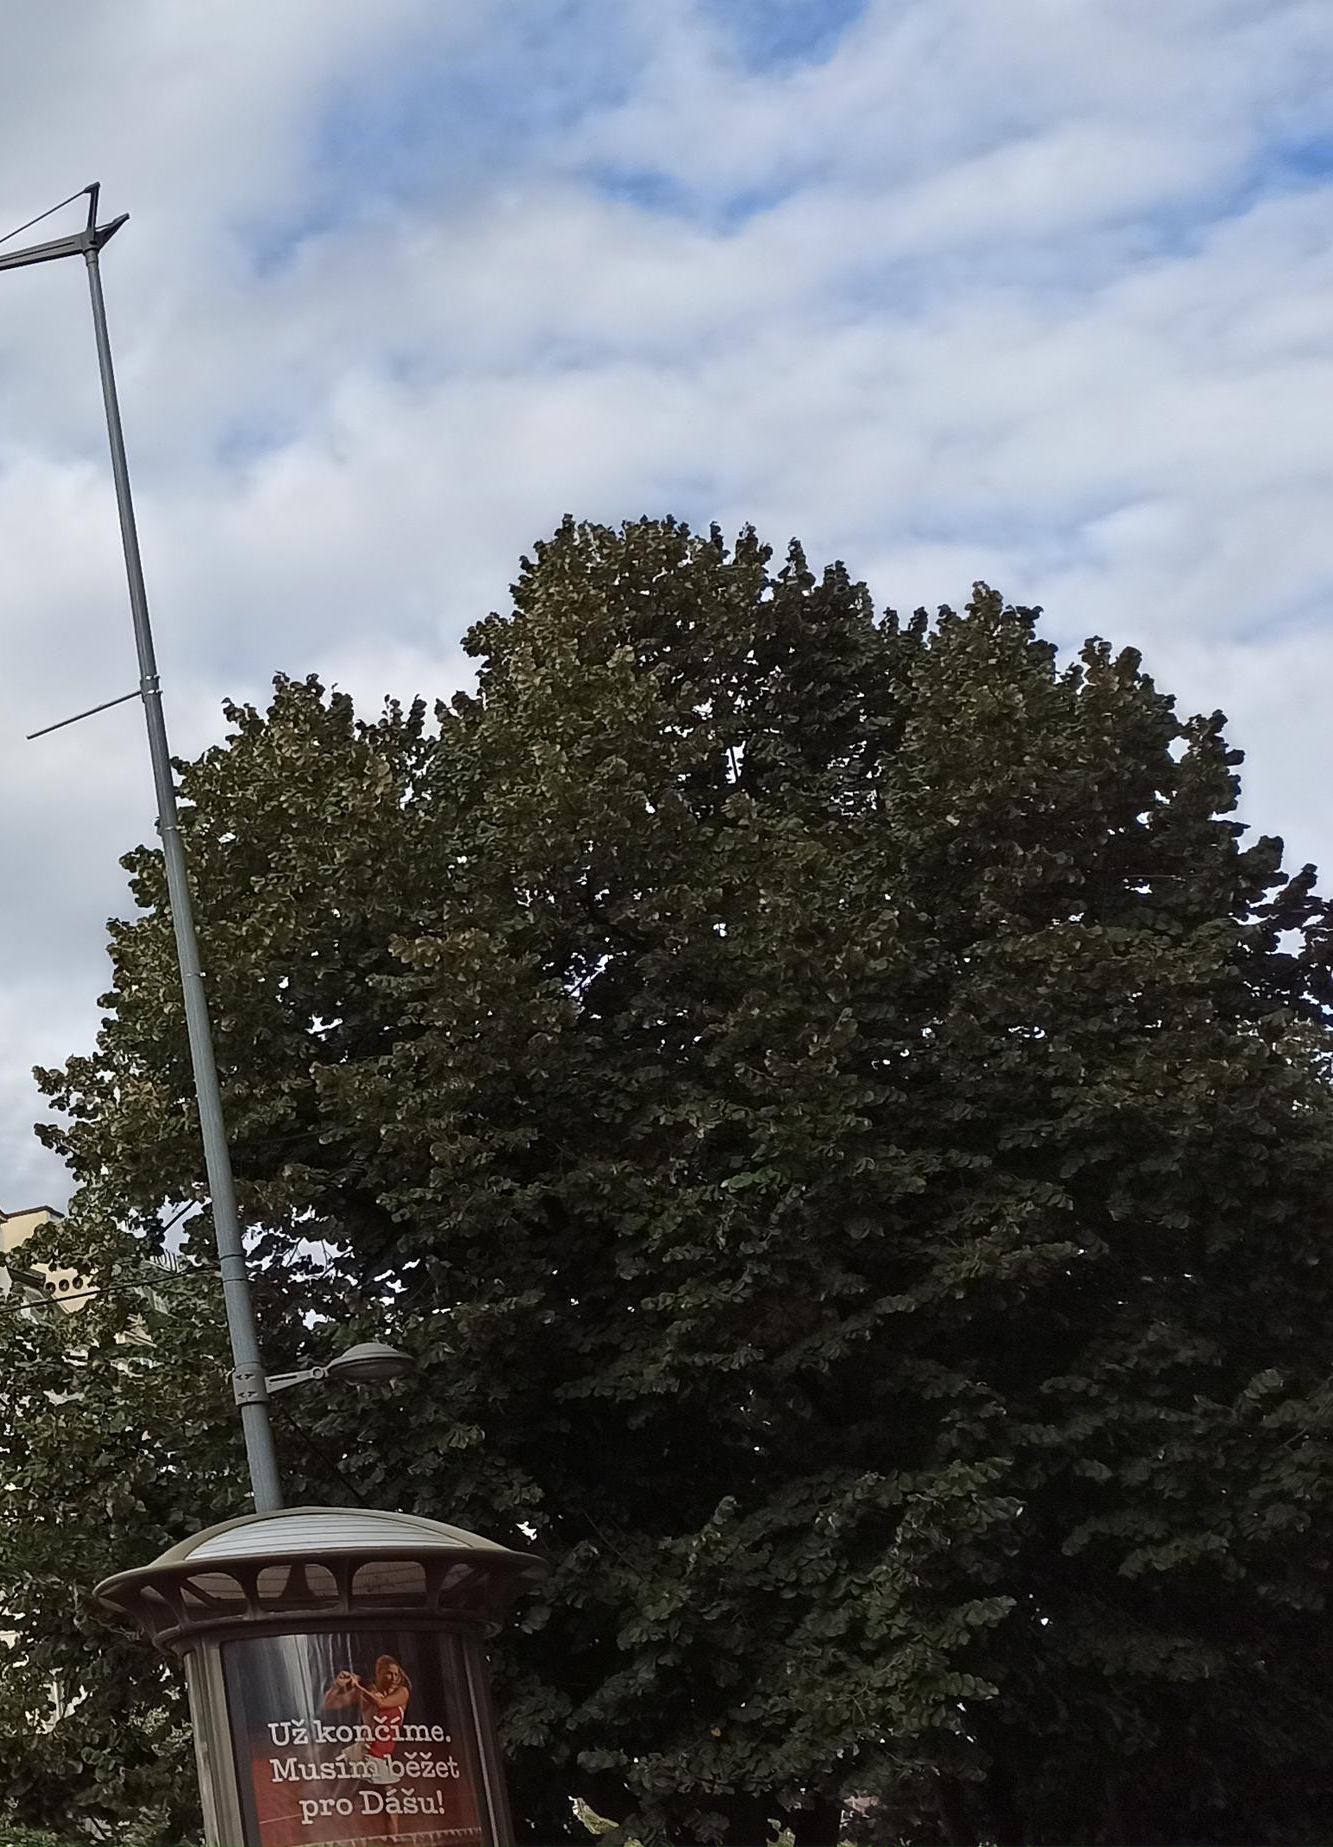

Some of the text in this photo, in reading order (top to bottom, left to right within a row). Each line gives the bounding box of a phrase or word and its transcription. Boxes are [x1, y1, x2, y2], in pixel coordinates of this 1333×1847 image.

[268, 1715, 452, 1746] Už končíme.
[269, 1751, 460, 1783] Musím běžet
[299, 1787, 446, 1825] pro Dášu!
